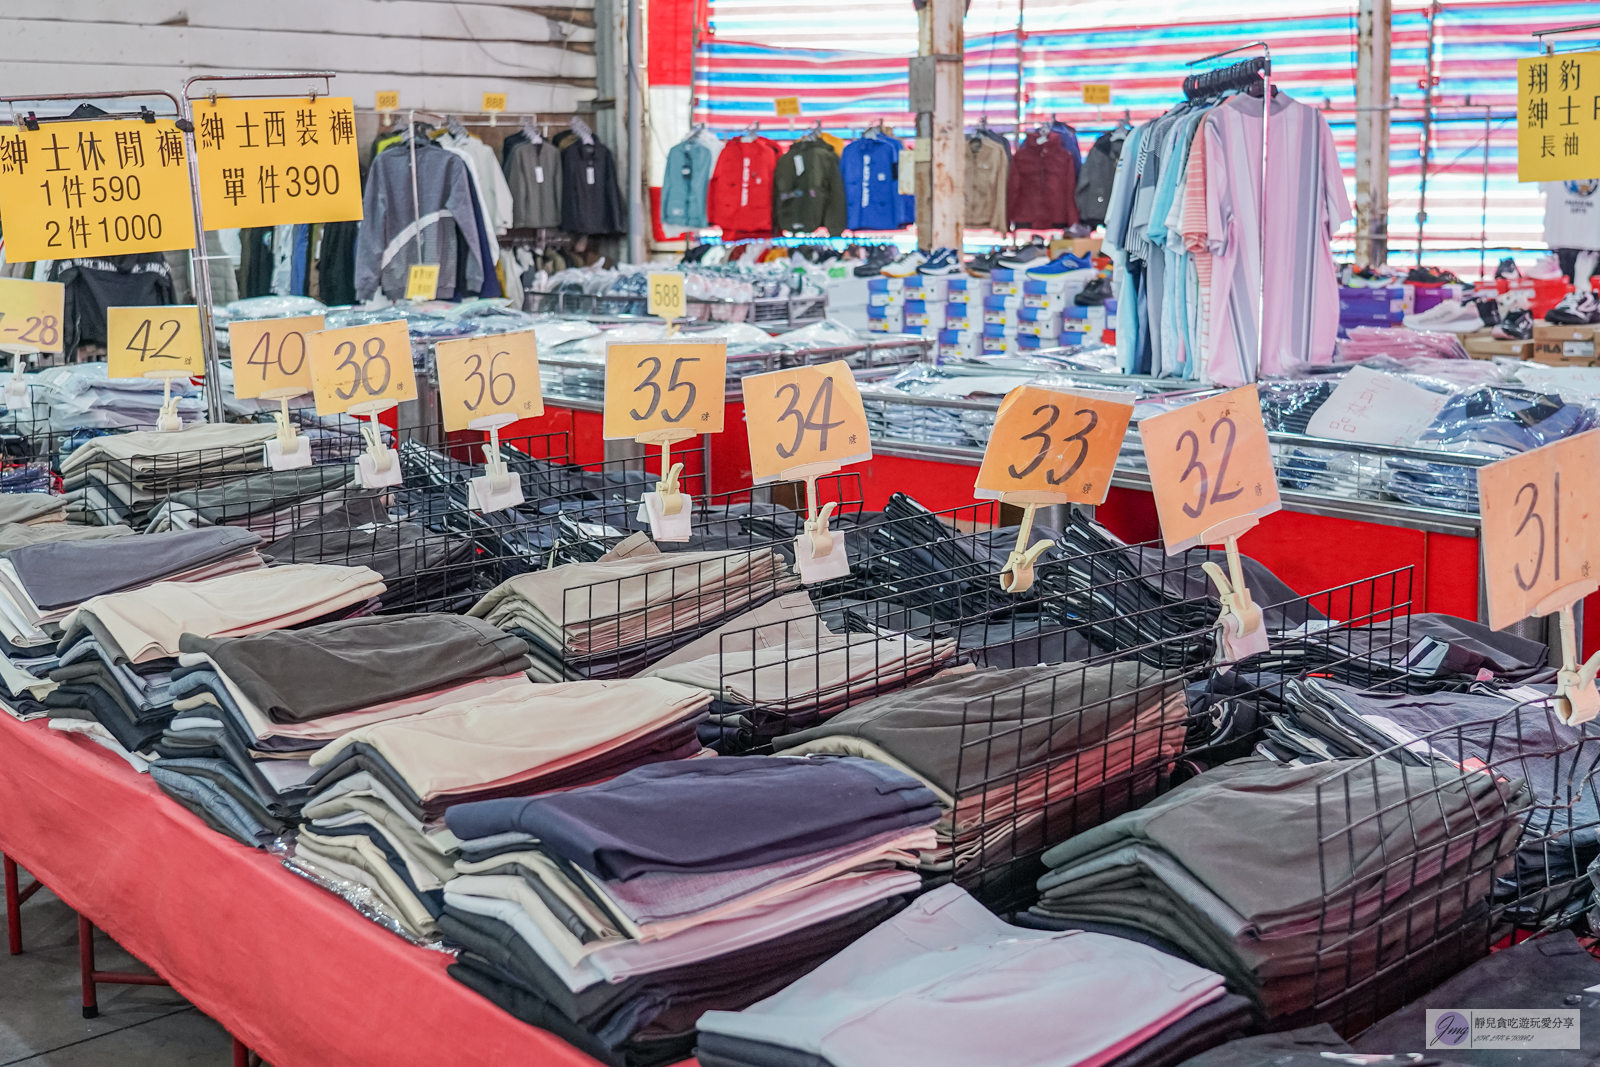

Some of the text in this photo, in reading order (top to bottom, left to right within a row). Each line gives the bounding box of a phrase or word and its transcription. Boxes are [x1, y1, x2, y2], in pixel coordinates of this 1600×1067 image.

[1527, 60, 1580, 94] 翔豹
[0, 128, 185, 175] 紳士休閒褲
[200, 109, 355, 150] 紳士西裝褲
[1540, 132, 1579, 158] 長袖
[40, 174, 142, 209] 1件590
[222, 164, 340, 206] 單件390
[45, 213, 163, 249] 2件1000
[655, 284, 679, 307] 588
[126, 319, 182, 361] 42
[246, 331, 306, 380] 40
[1535, 343, 1561, 354] FILA
[333, 336, 391, 400] 38
[463, 351, 516, 411] 36
[629, 356, 700, 423] 35
[775, 376, 845, 459] 34
[1007, 403, 1099, 485] 33
[1175, 417, 1244, 519] 32
[1514, 471, 1560, 592] 31
